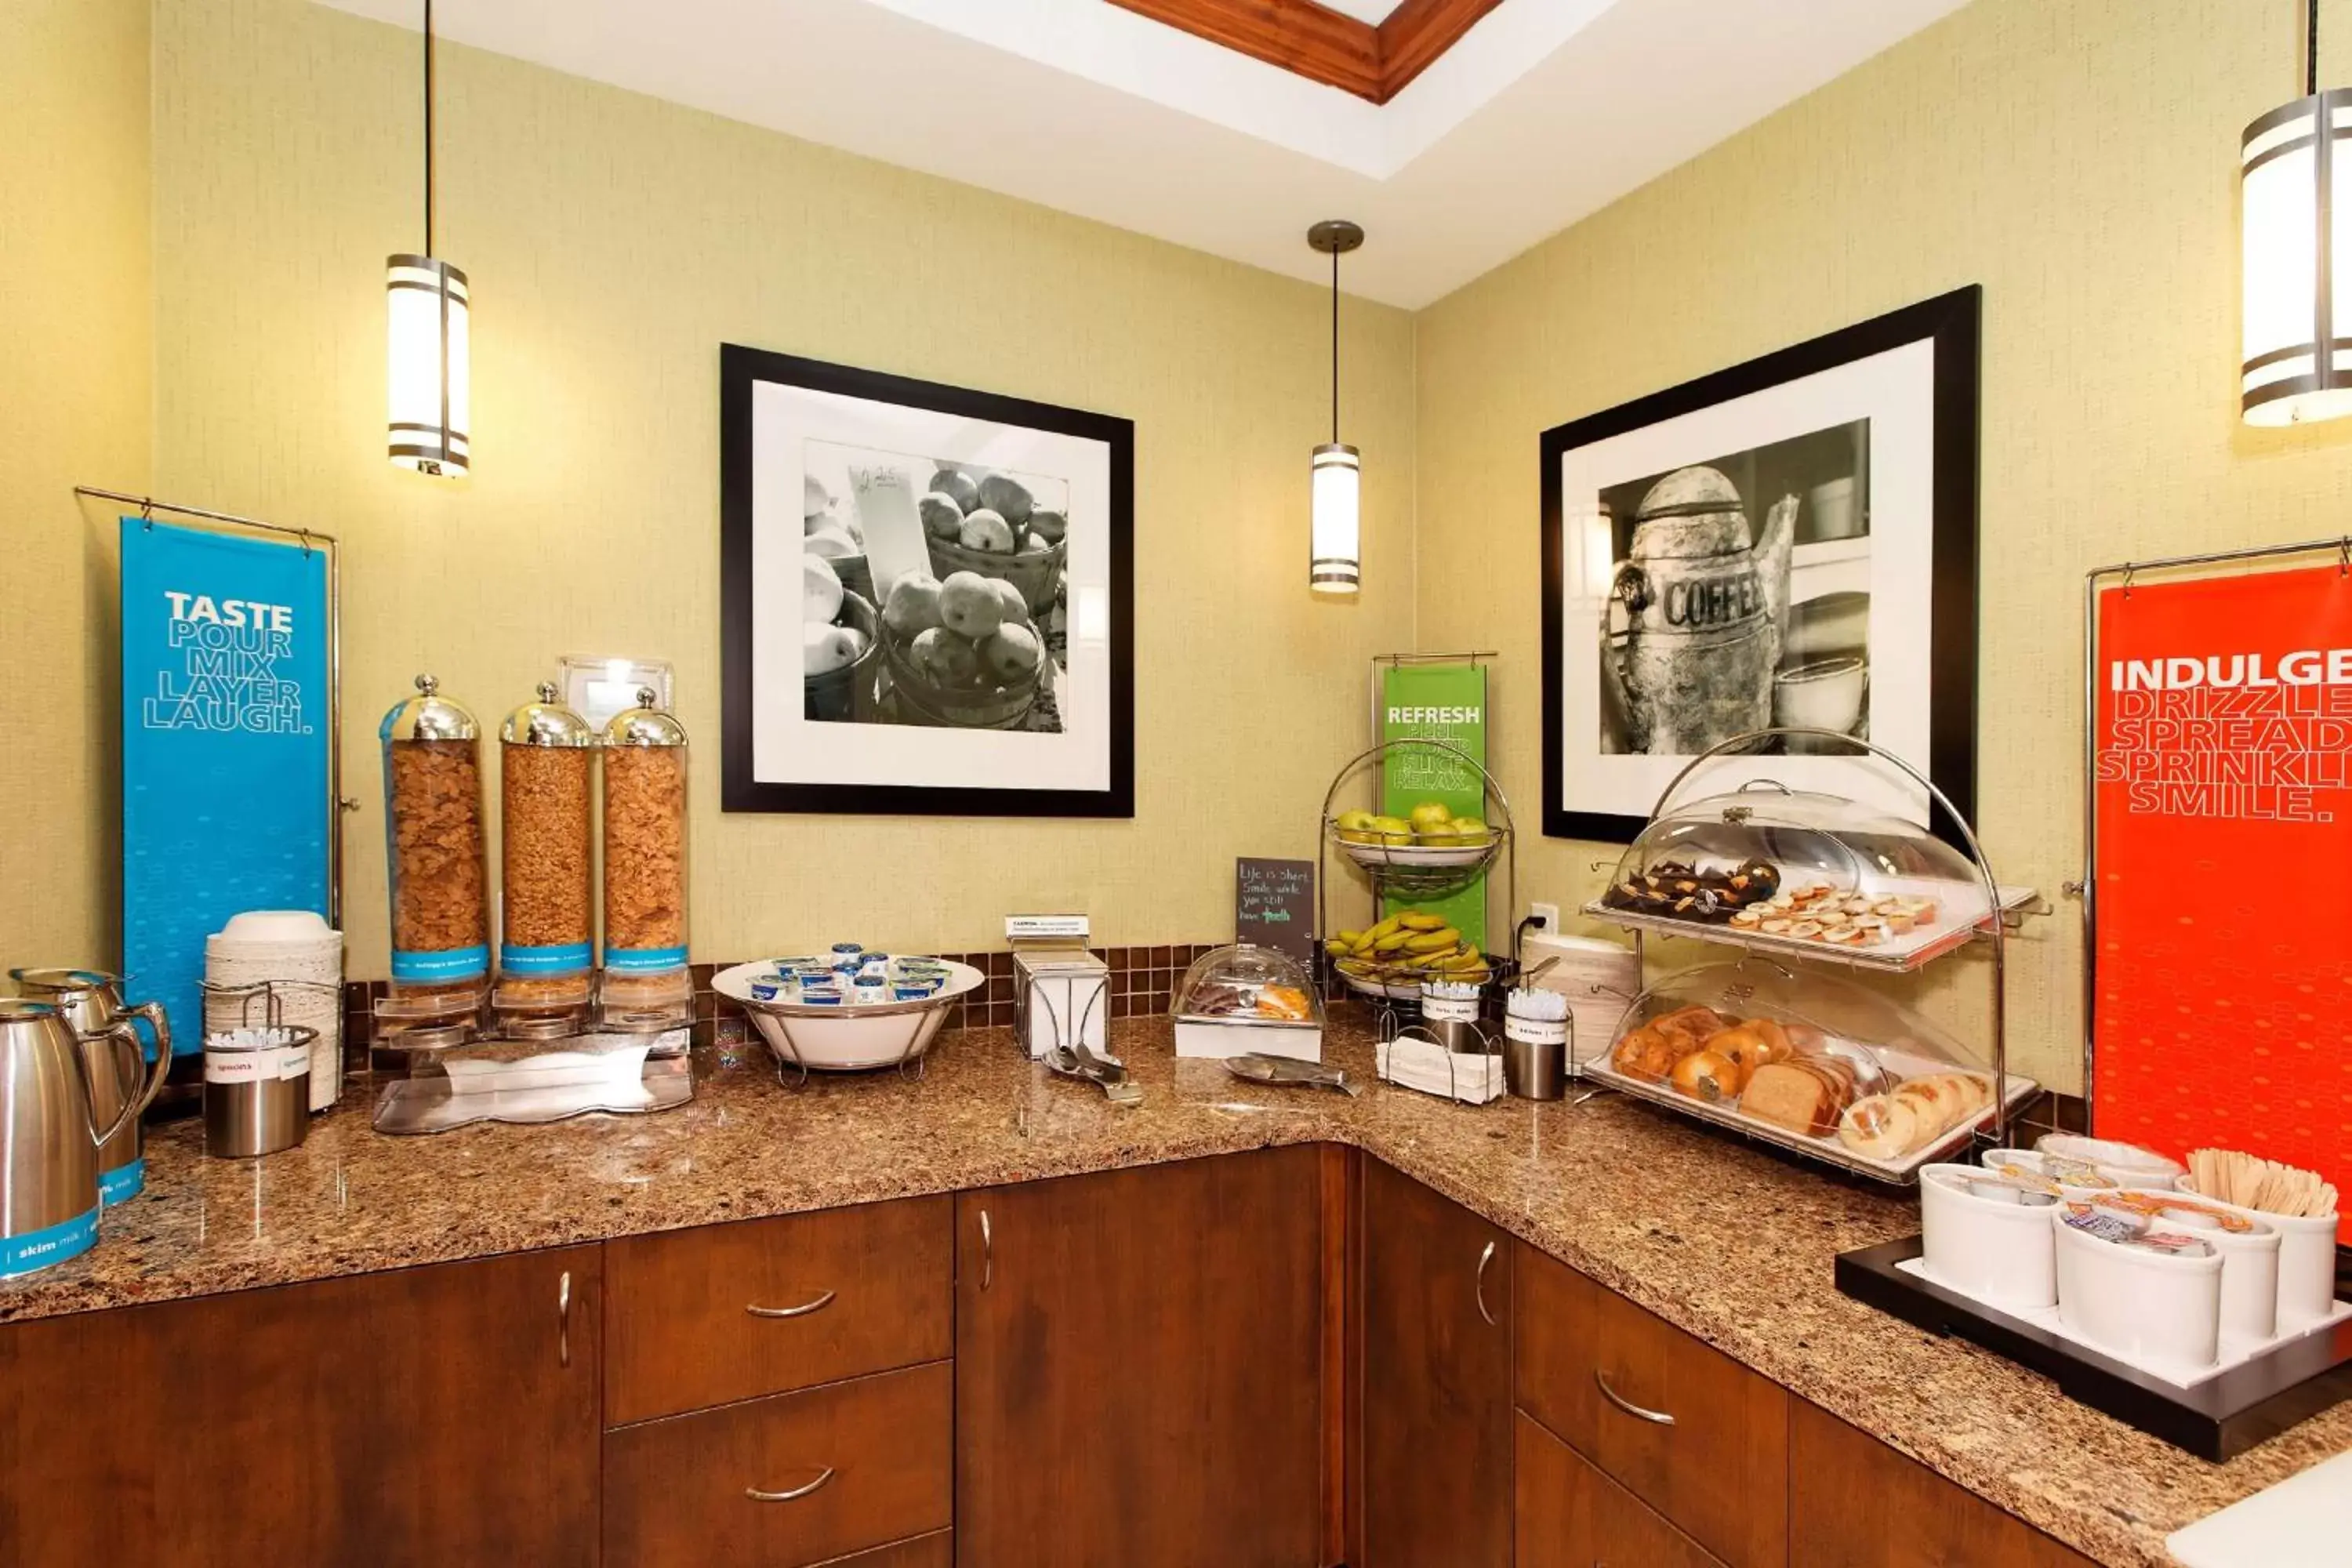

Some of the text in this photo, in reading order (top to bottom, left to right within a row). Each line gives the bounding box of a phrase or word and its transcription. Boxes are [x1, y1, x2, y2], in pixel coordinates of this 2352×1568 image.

[165, 590, 293, 633] TASTE
[169, 617, 293, 658] POUR
[187, 646, 276, 680] MIX
[2111, 648, 2352, 691] INDULGE
[159, 670, 302, 708] LAYER
[2114, 683, 2352, 721] DRIZZLE
[143, 698, 314, 735] LAUGH.
[1388, 706, 1479, 724] REFRESH
[2111, 717, 2352, 753] SPREAD
[2129, 780, 2334, 822] SMILE.
[18, 1241, 56, 1258] skim
